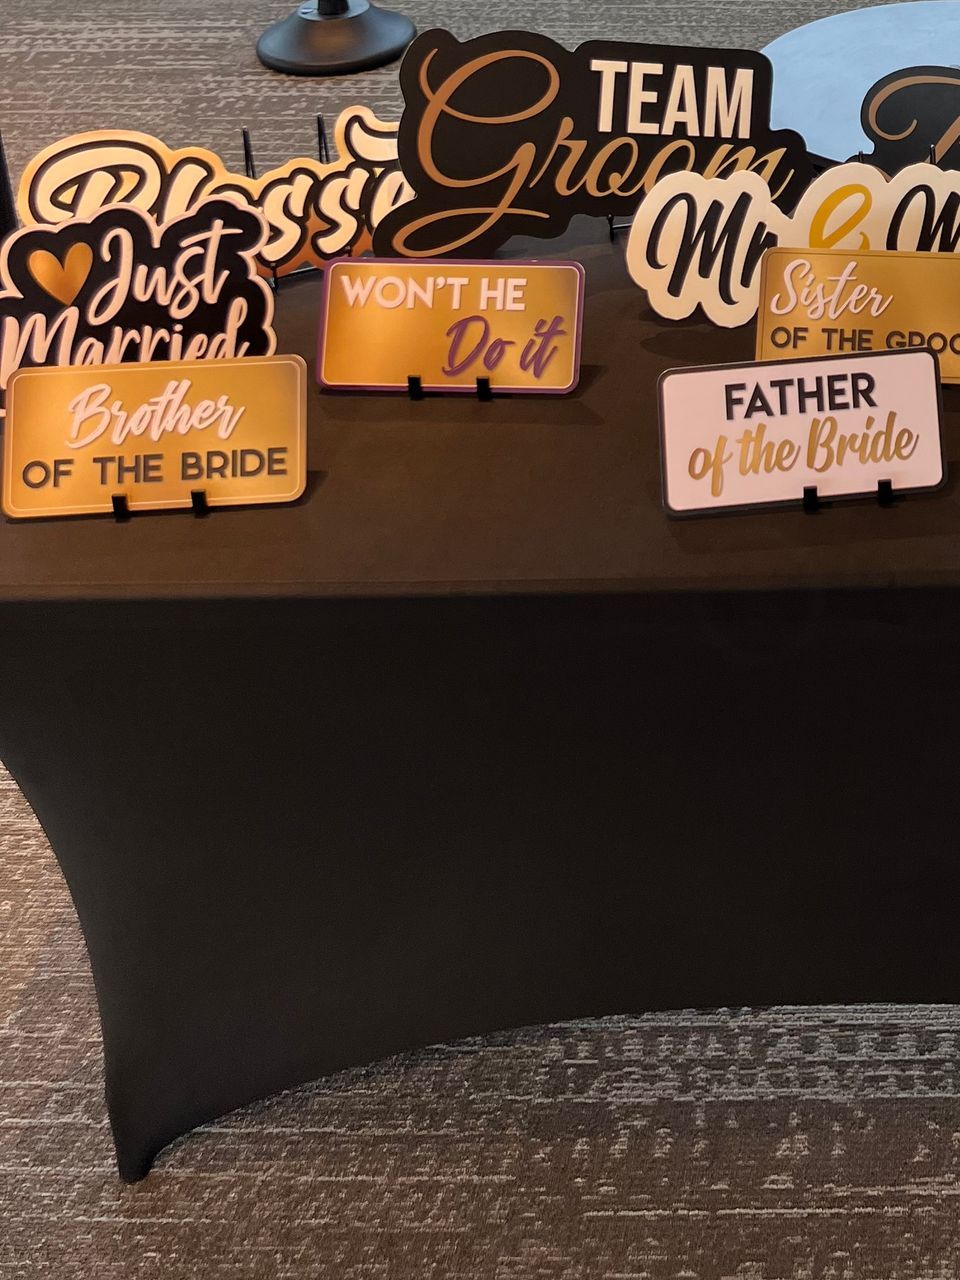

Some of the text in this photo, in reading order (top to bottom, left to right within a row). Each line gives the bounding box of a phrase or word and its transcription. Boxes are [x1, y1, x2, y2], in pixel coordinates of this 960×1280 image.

[590, 59, 754, 140] TEAM
[392, 48, 795, 258] Groom
[88, 219, 244, 326] Just
[646, 191, 778, 306] Mr
[340, 275, 527, 311] WON'T HE
[770, 258, 894, 320] Sister
[0, 297, 250, 389] Married
[442, 315, 567, 379] Do it
[771, 326, 809, 349] OF
[822, 327, 873, 351] THE
[64, 379, 245, 449] Brother
[724, 372, 877, 420] FATHER
[22, 447, 288, 489] OF THE BRIDE
[688, 410, 919, 497] of the Bride
